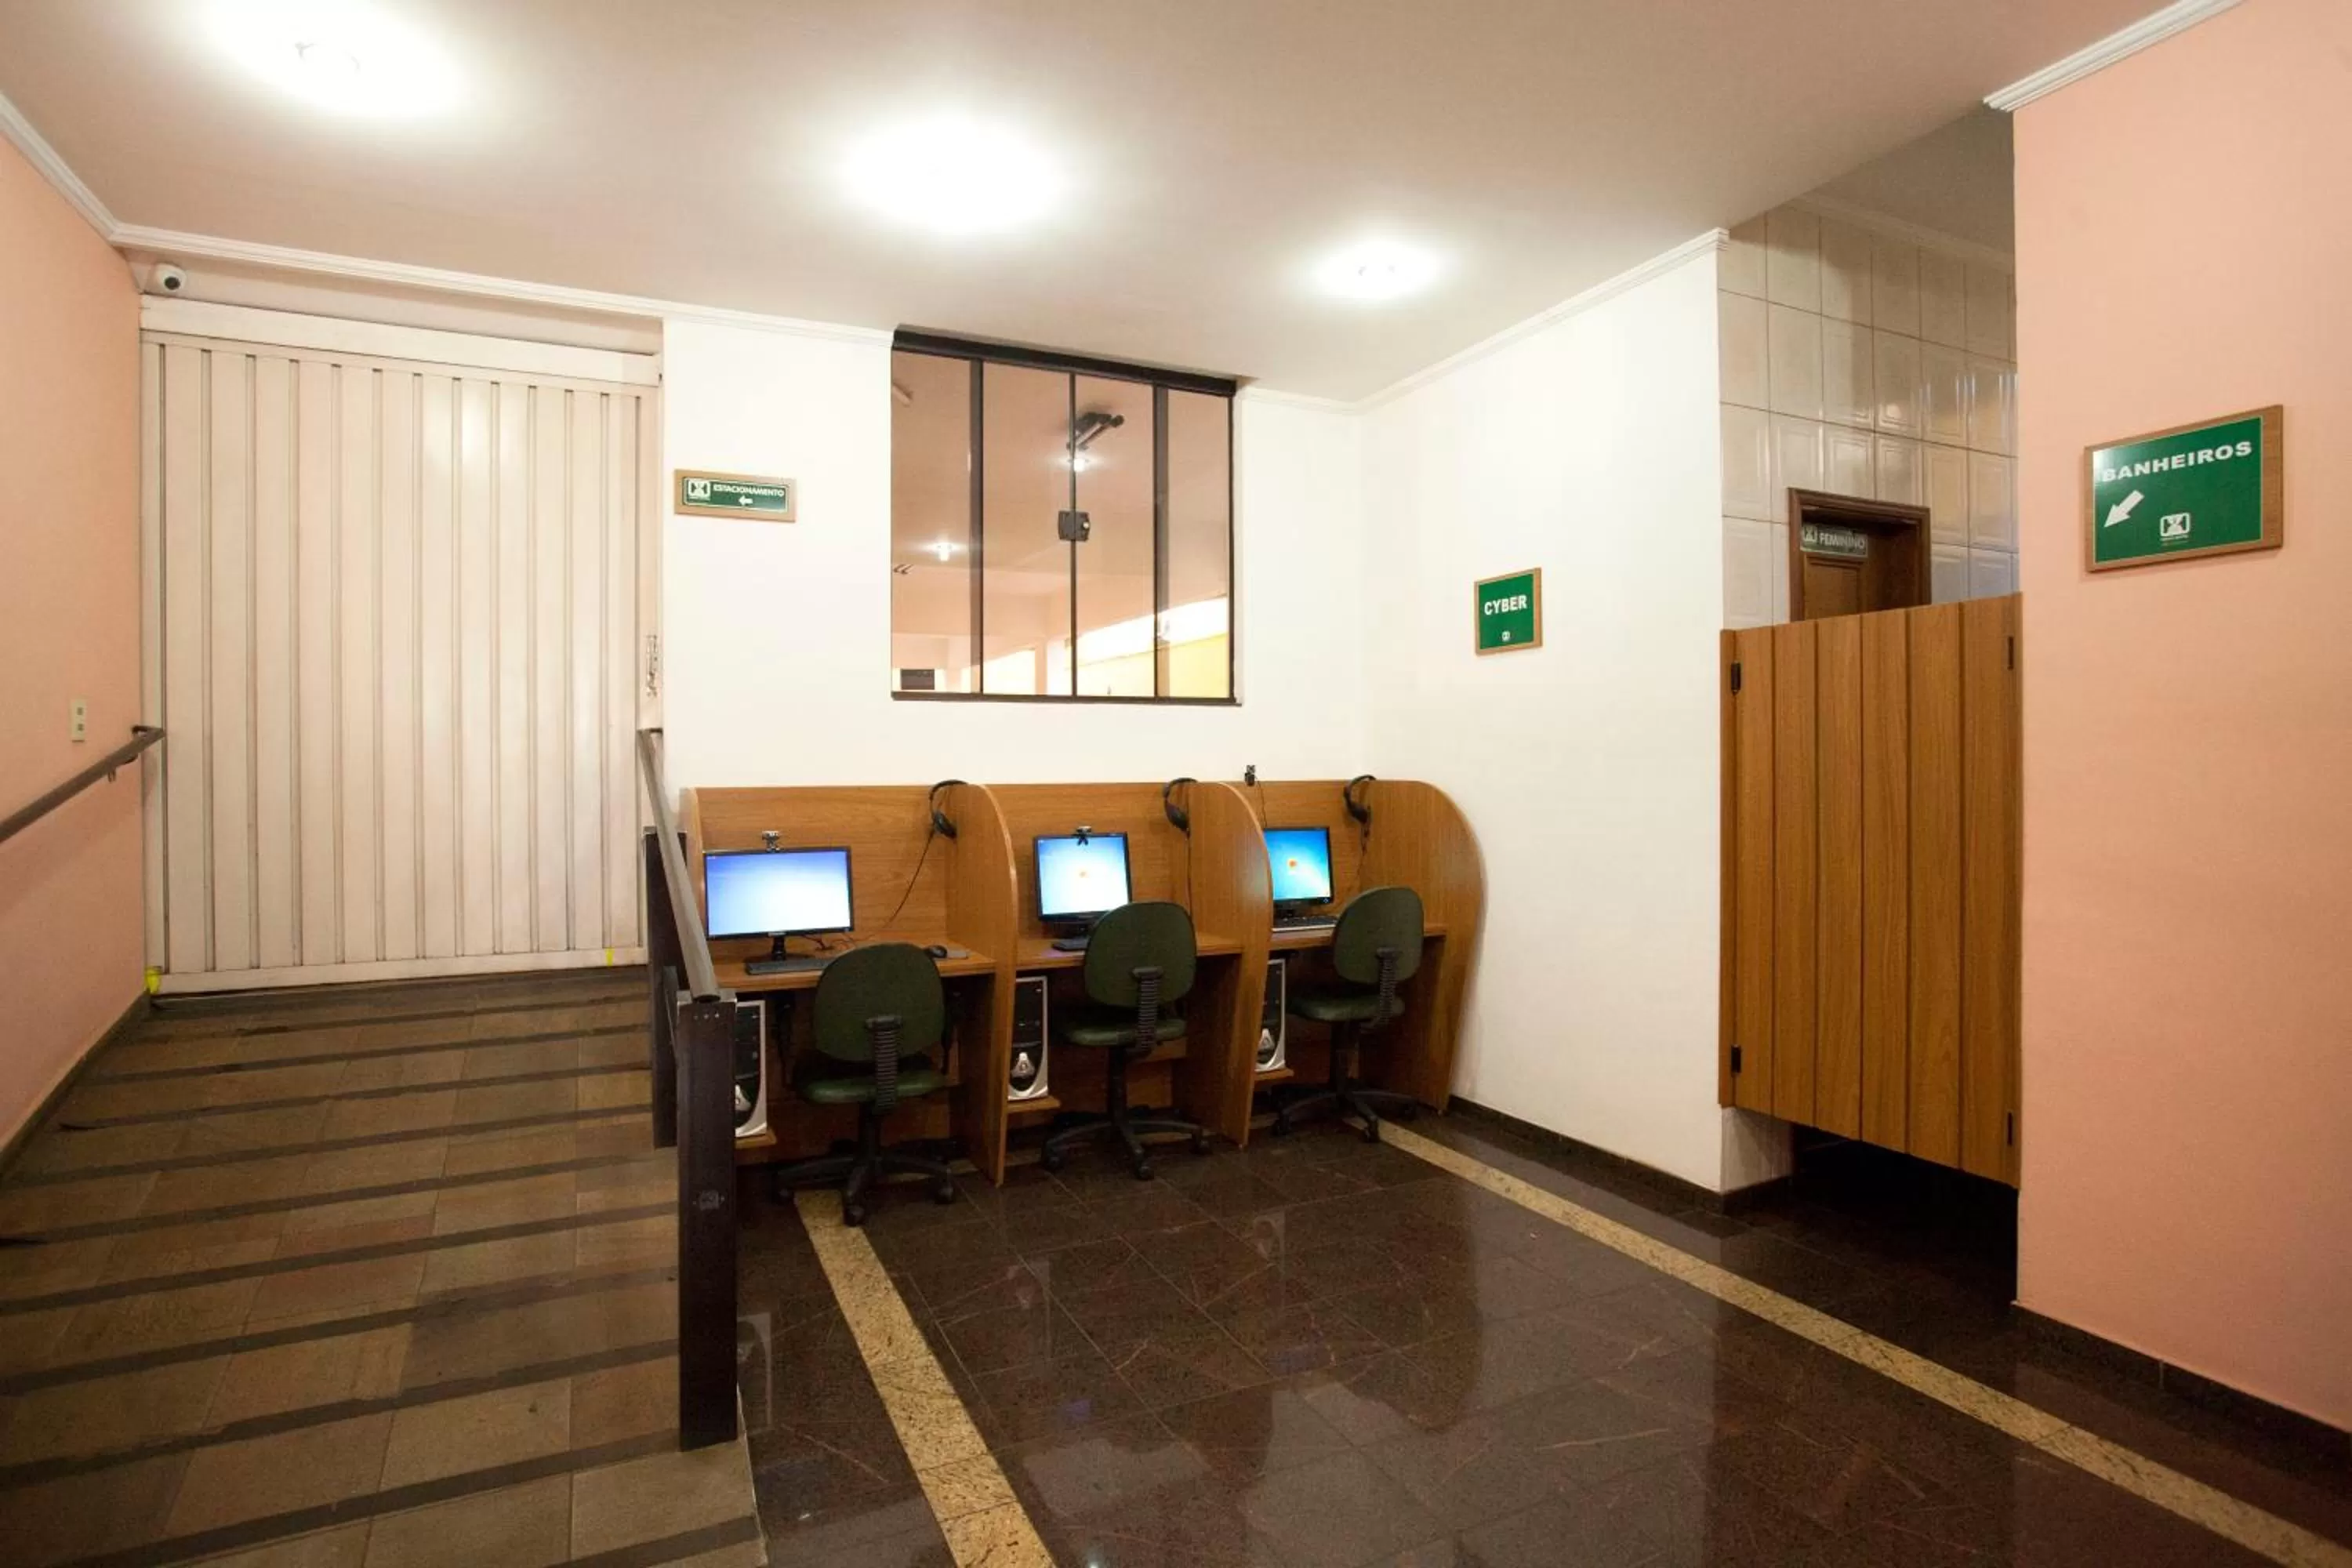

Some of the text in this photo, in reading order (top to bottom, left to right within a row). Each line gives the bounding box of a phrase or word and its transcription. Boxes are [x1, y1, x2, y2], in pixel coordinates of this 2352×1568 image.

[2101, 441, 2252, 482] BANHEIROS
[713, 484, 785, 497] ESTACIONAMENTO
[1484, 594, 1528, 615] CYBER
